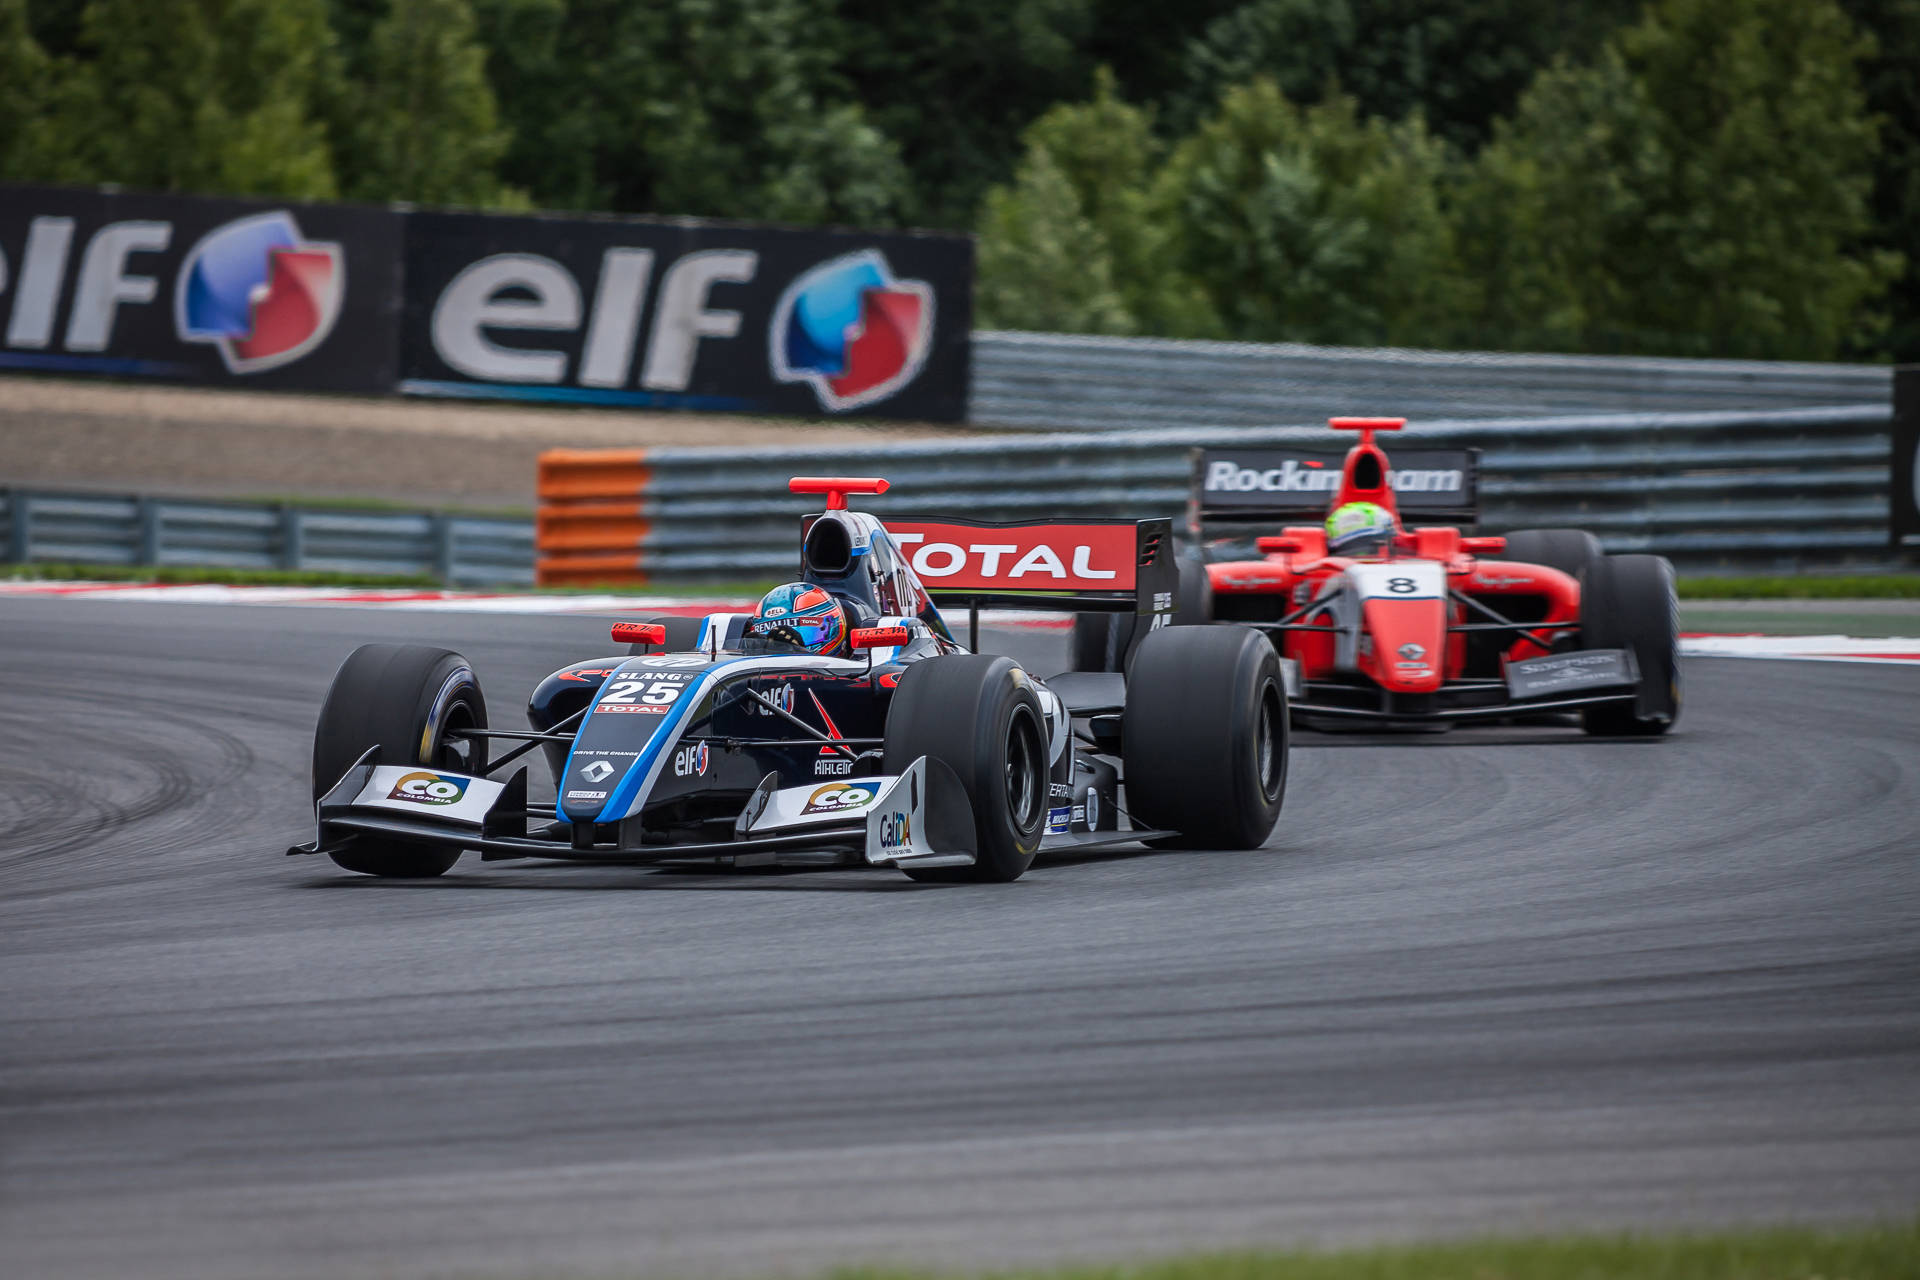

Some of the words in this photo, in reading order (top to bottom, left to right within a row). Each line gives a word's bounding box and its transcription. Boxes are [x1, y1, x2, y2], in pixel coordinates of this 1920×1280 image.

[0, 216, 173, 351] lf
[430, 247, 758, 391] elf
[1387, 577, 1418, 594] 8
[599, 681, 685, 705] 25
[600, 705, 664, 713] TOTAL
[675, 745, 697, 777] elf
[401, 779, 459, 798] CO
[814, 788, 870, 807] CO
[396, 793, 452, 804] COLOMBIA
[809, 802, 864, 812] COLOMBIA
